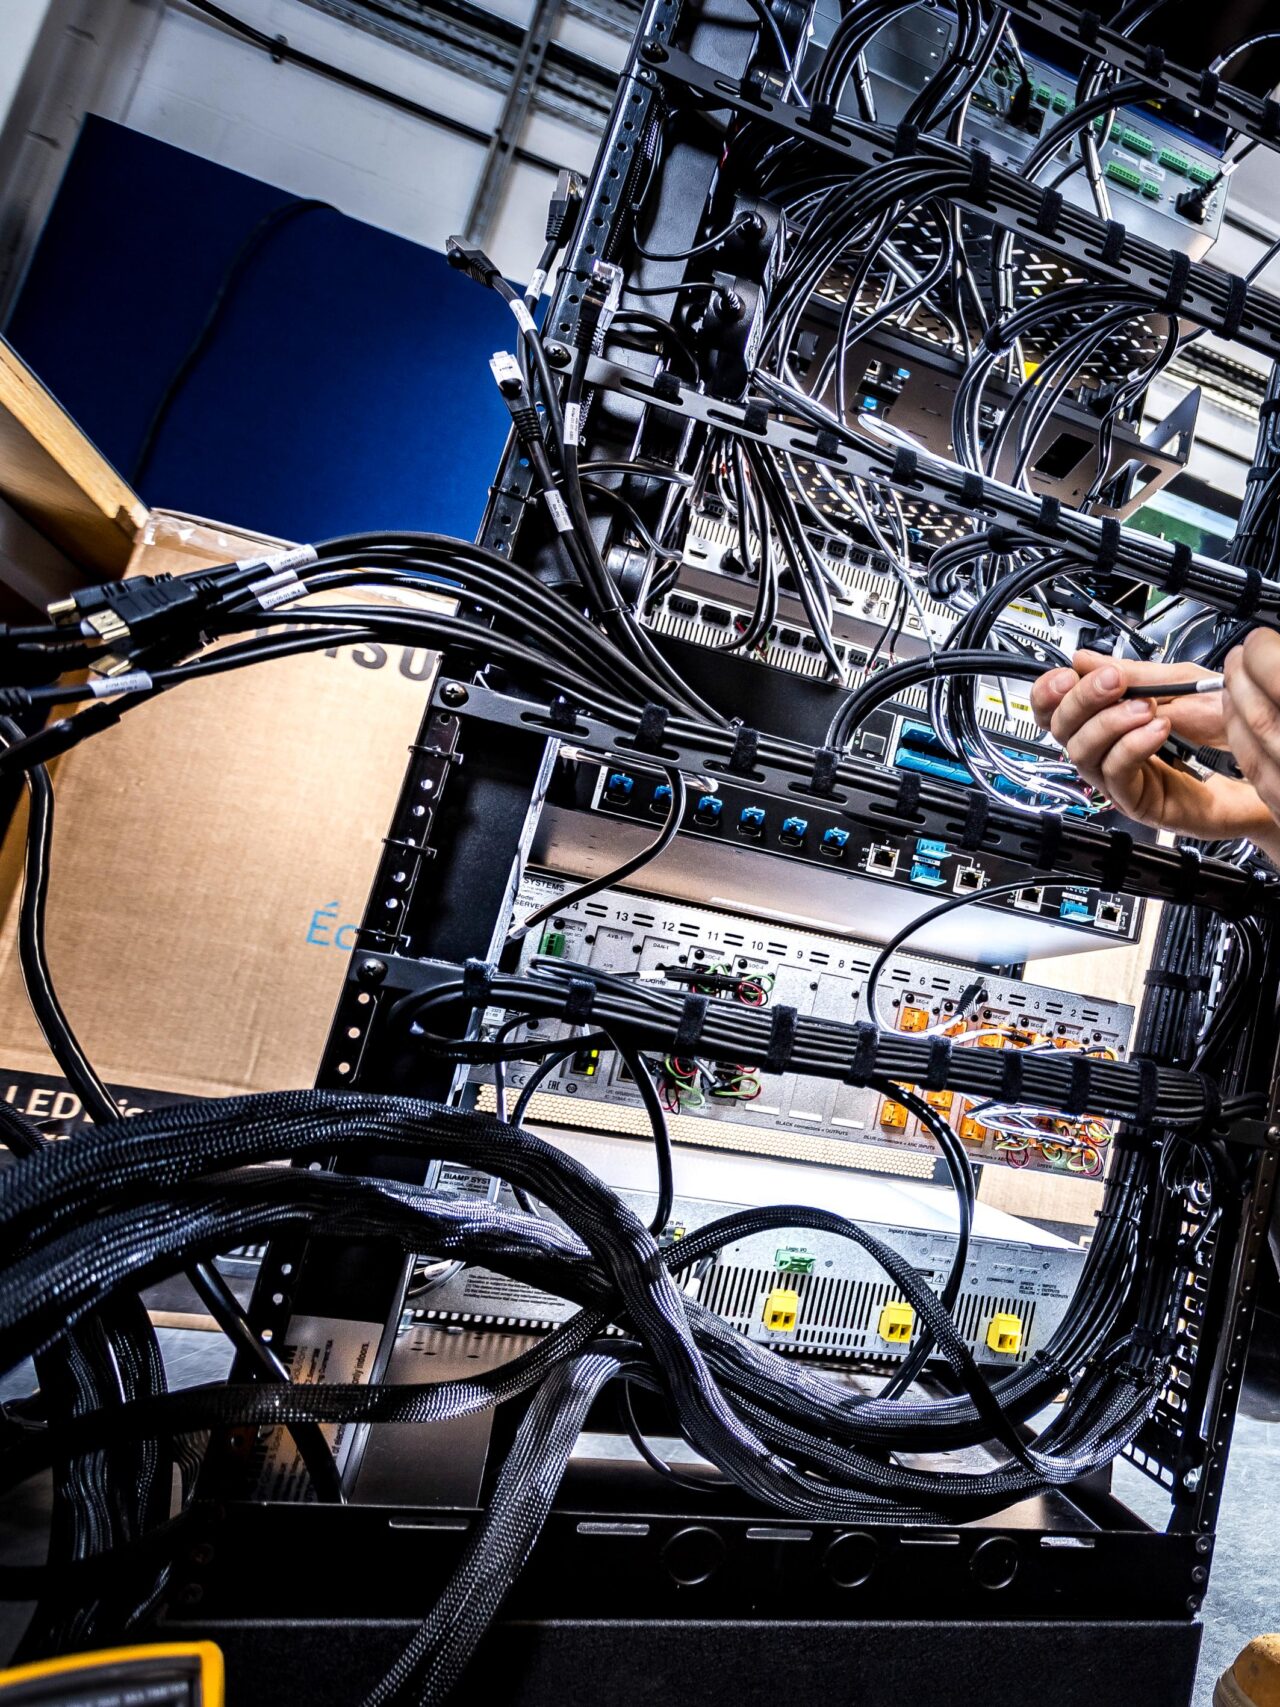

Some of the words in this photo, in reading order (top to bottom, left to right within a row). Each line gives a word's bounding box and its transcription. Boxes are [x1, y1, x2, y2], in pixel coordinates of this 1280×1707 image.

[523, 877, 566, 892] SYSTEMS
[615, 911, 629, 922] 13
[661, 921, 676, 932] 12
[707, 931, 719, 941] 11
[751, 941, 764, 951] 10
[796, 950, 803, 959] 9
[838, 959, 845, 968] 8
[919, 977, 926, 985] 6
[958, 985, 965, 993] 5
[996, 993, 1003, 1001] 4
[1034, 1001, 1040, 1010] 3
[1070, 1009, 1077, 1018] 2
[443, 1173, 469, 1182] BIAMP
